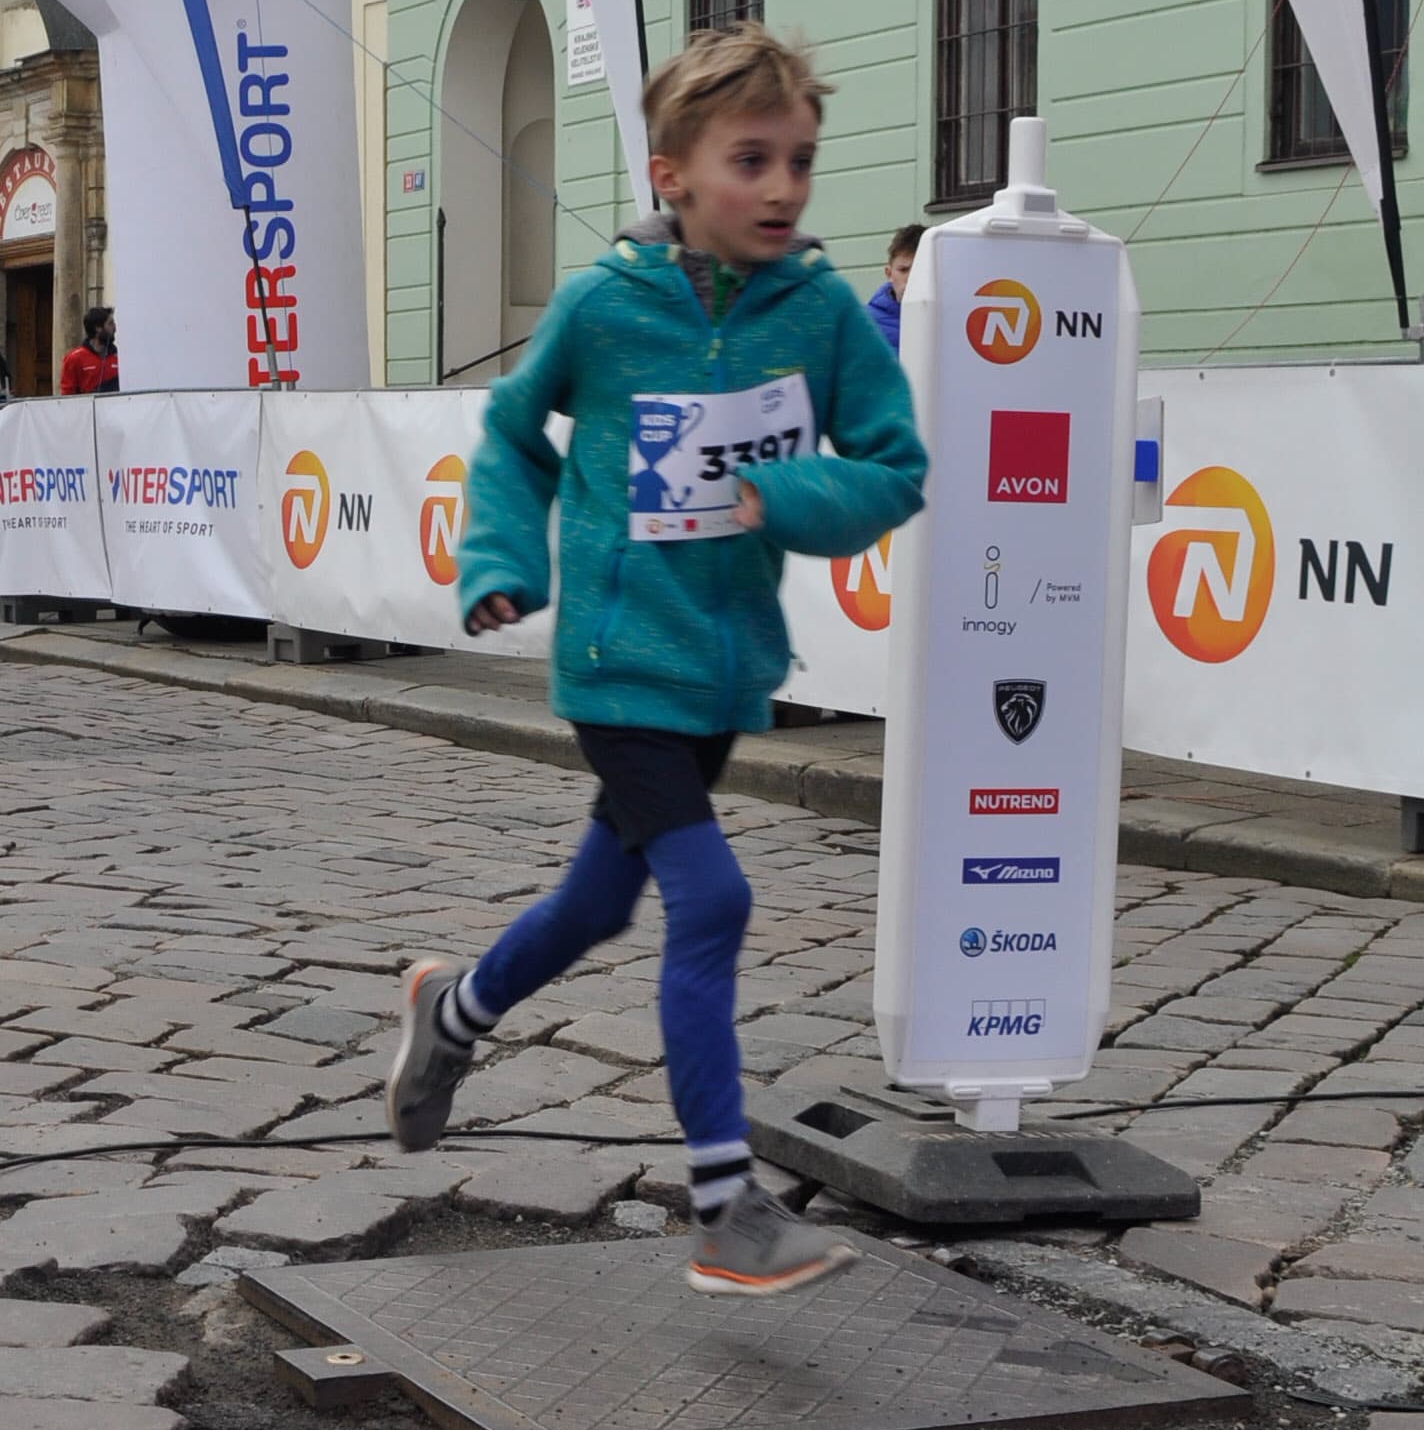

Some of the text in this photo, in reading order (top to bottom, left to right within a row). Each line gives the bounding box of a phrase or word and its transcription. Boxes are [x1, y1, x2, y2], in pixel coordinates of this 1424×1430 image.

[1056, 310, 1103, 339] NN
[996, 477, 1059, 496] AVON
[337, 492, 373, 533] NN
[176, 521, 214, 538] SPORT
[1298, 538, 1394, 607] NN
[962, 616, 1017, 635] innogy
[975, 795, 1055, 809] NUTREND
[990, 930, 1057, 952] ŠKODA
[967, 1013, 1042, 1036] KPMG
